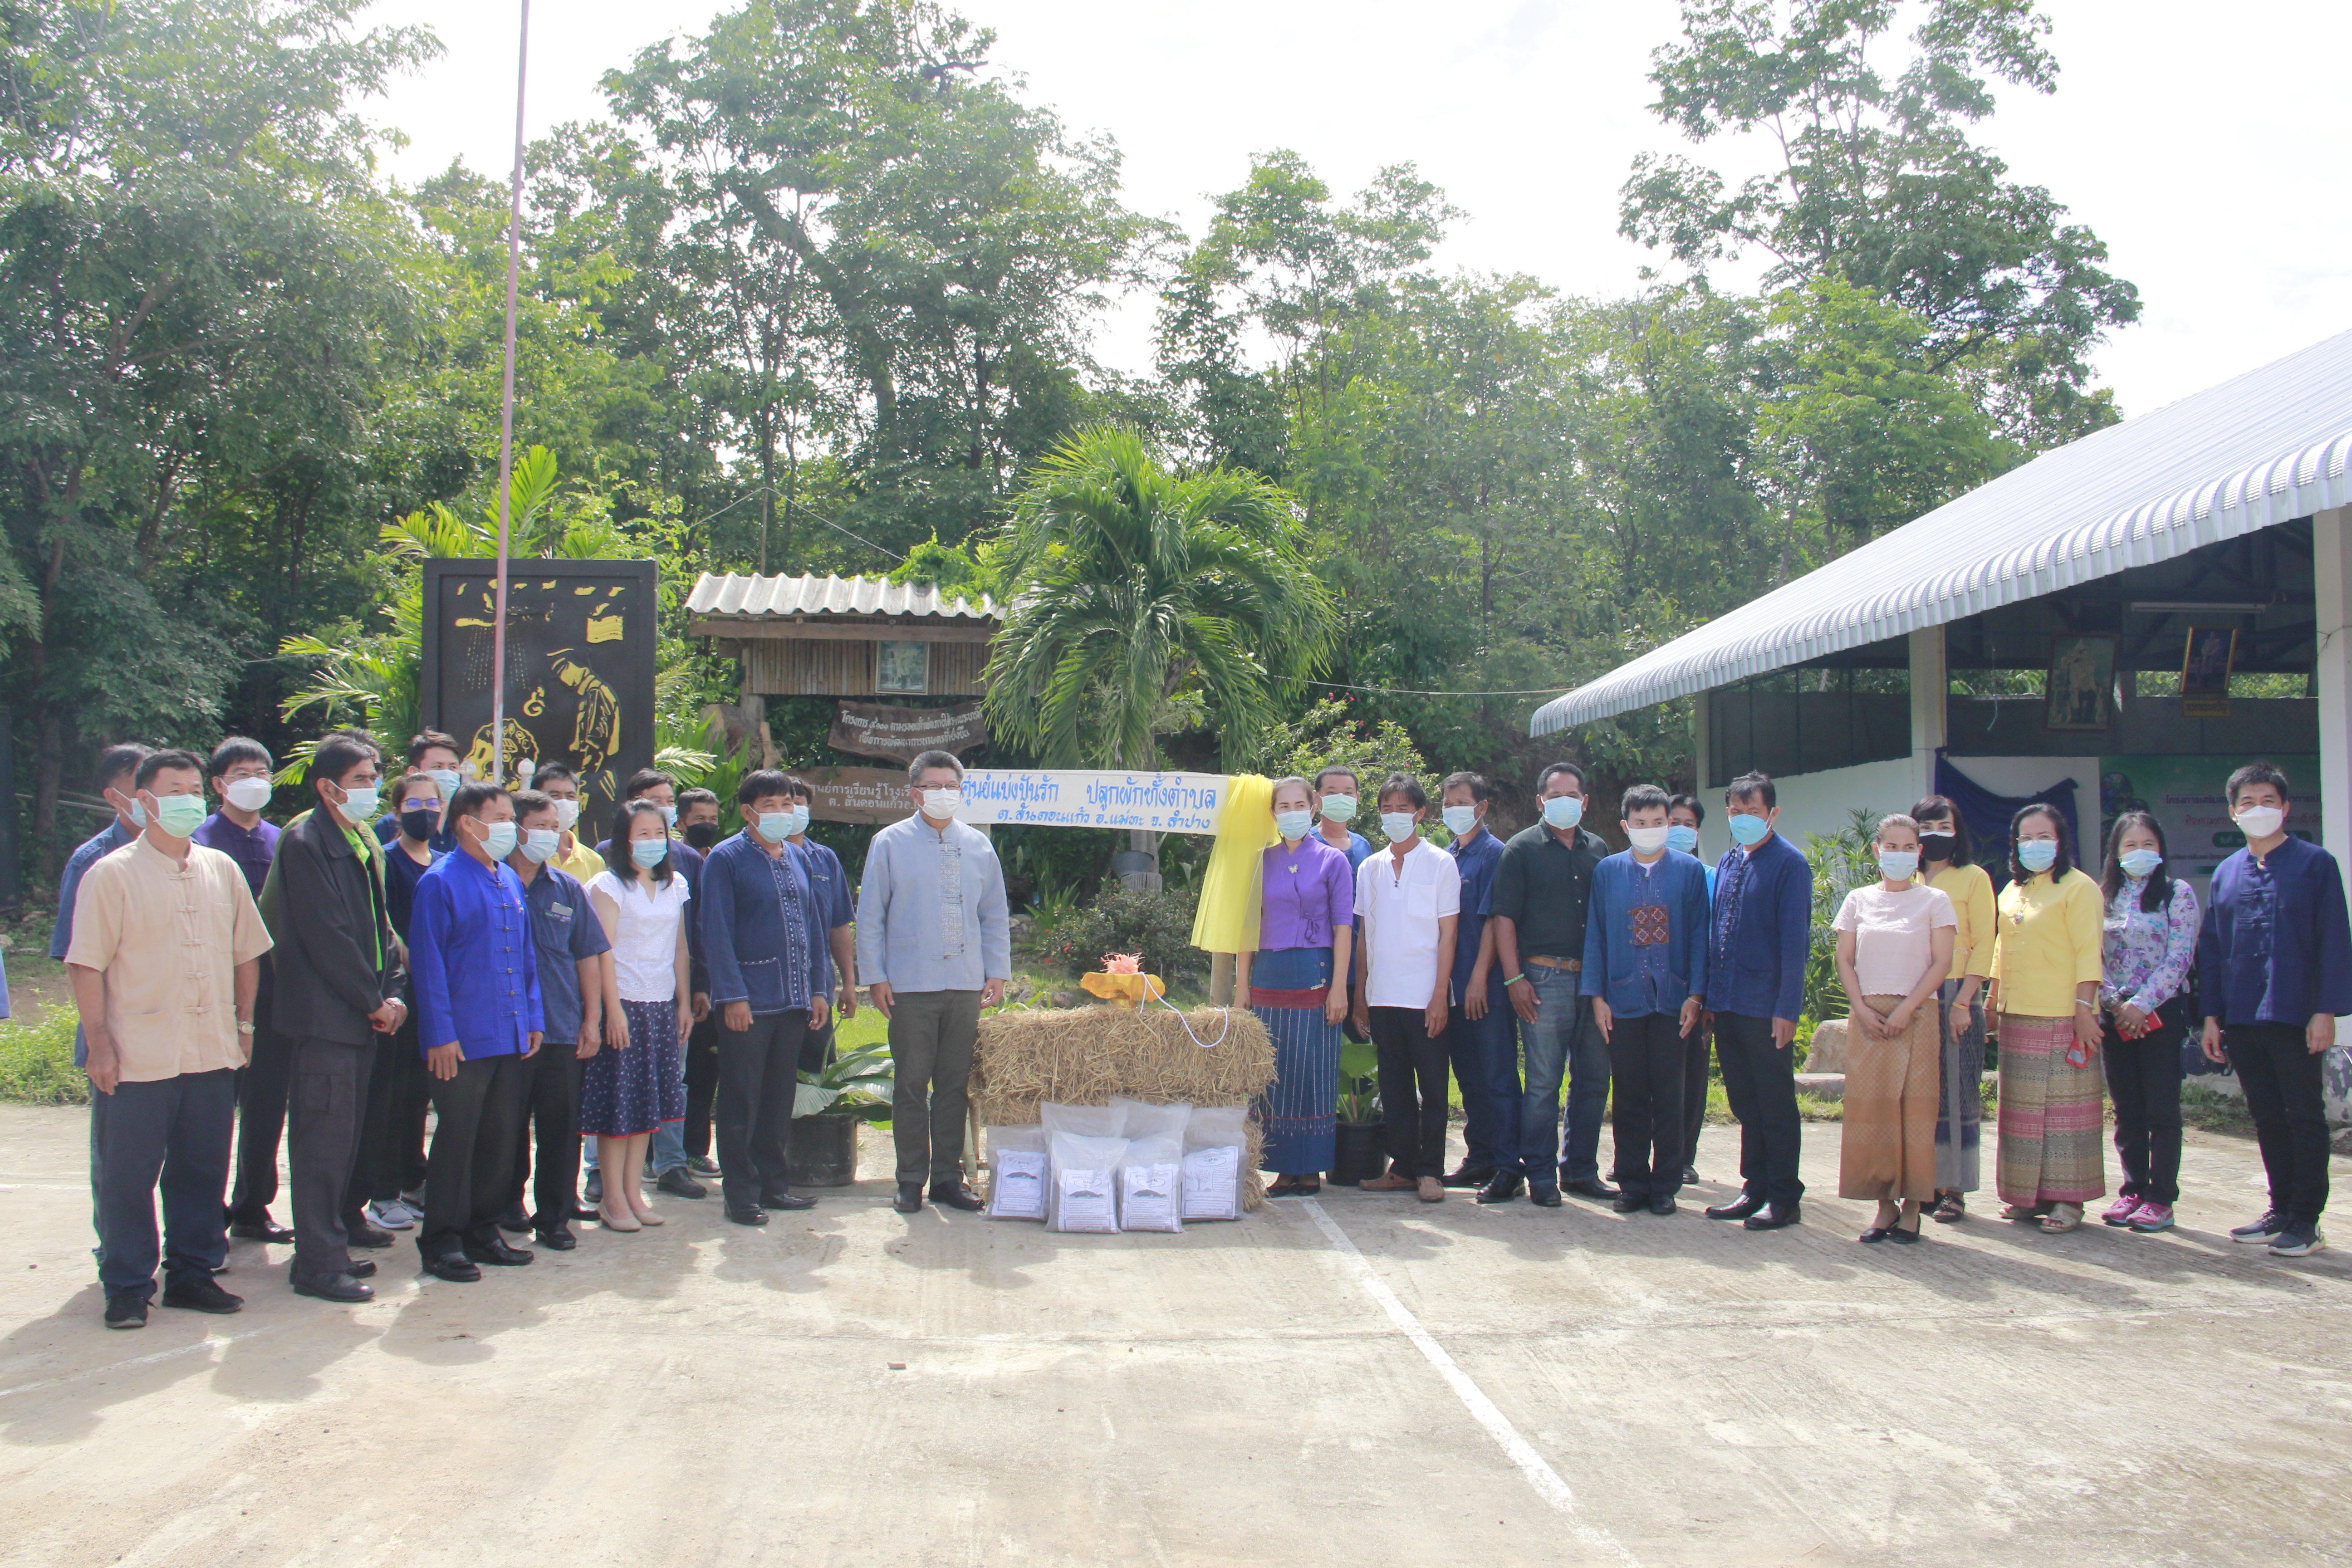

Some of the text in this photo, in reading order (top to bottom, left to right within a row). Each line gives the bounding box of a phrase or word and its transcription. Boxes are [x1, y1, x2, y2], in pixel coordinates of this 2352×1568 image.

[841, 710, 869, 728] โครงการ
[961, 773, 1217, 812] ศูนย์แบ่งปันรัก ปลูกผักทั้งตำบล
[1167, 810, 1211, 829] ลำปาง
